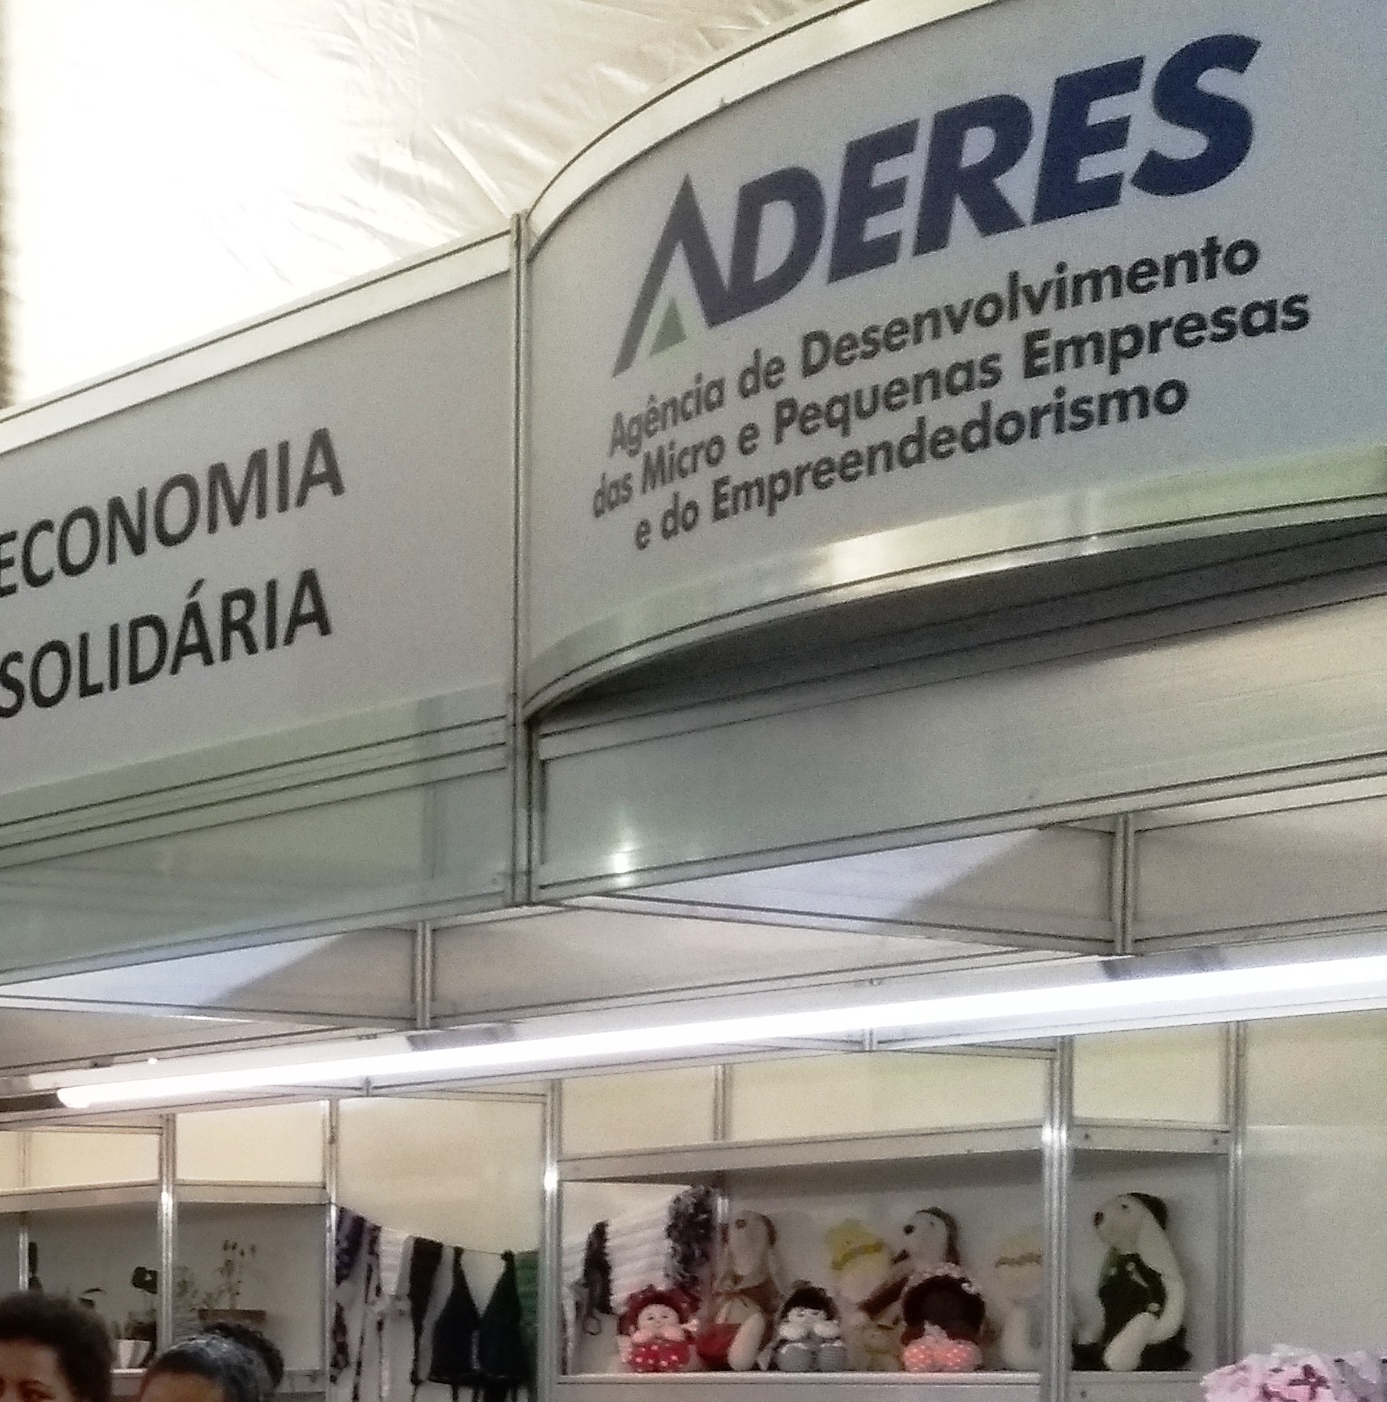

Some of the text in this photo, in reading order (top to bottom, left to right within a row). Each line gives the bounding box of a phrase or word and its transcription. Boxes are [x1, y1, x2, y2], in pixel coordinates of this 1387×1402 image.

[612, 33, 1261, 378] ADERES
[592, 292, 1311, 519] das Micro e Pequenas Empresas
[609, 235, 1260, 458] Agência de Desenvolvimento
[635, 379, 1189, 550] e do Empreendedorismo
